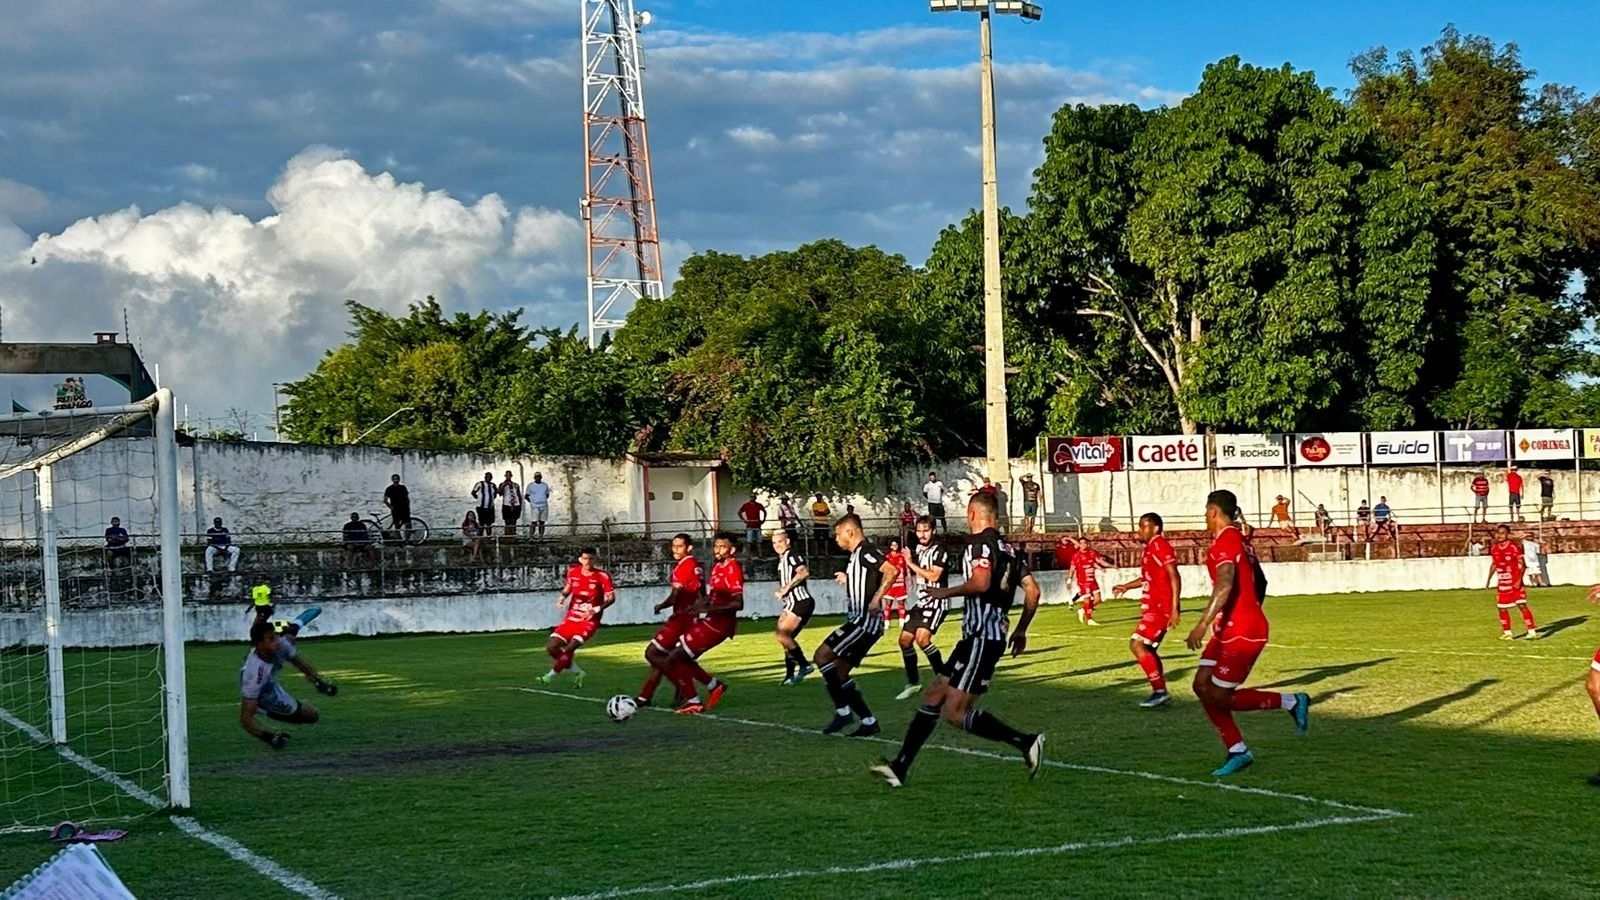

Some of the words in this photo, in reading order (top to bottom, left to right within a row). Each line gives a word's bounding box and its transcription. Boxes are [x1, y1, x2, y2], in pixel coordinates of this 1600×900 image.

[53, 400, 92, 410] FRANGO
[1531, 440, 1571, 450] CORINGA
[1138, 438, 1198, 463] caeté
[1240, 449, 1280, 458] ROCHEDO
